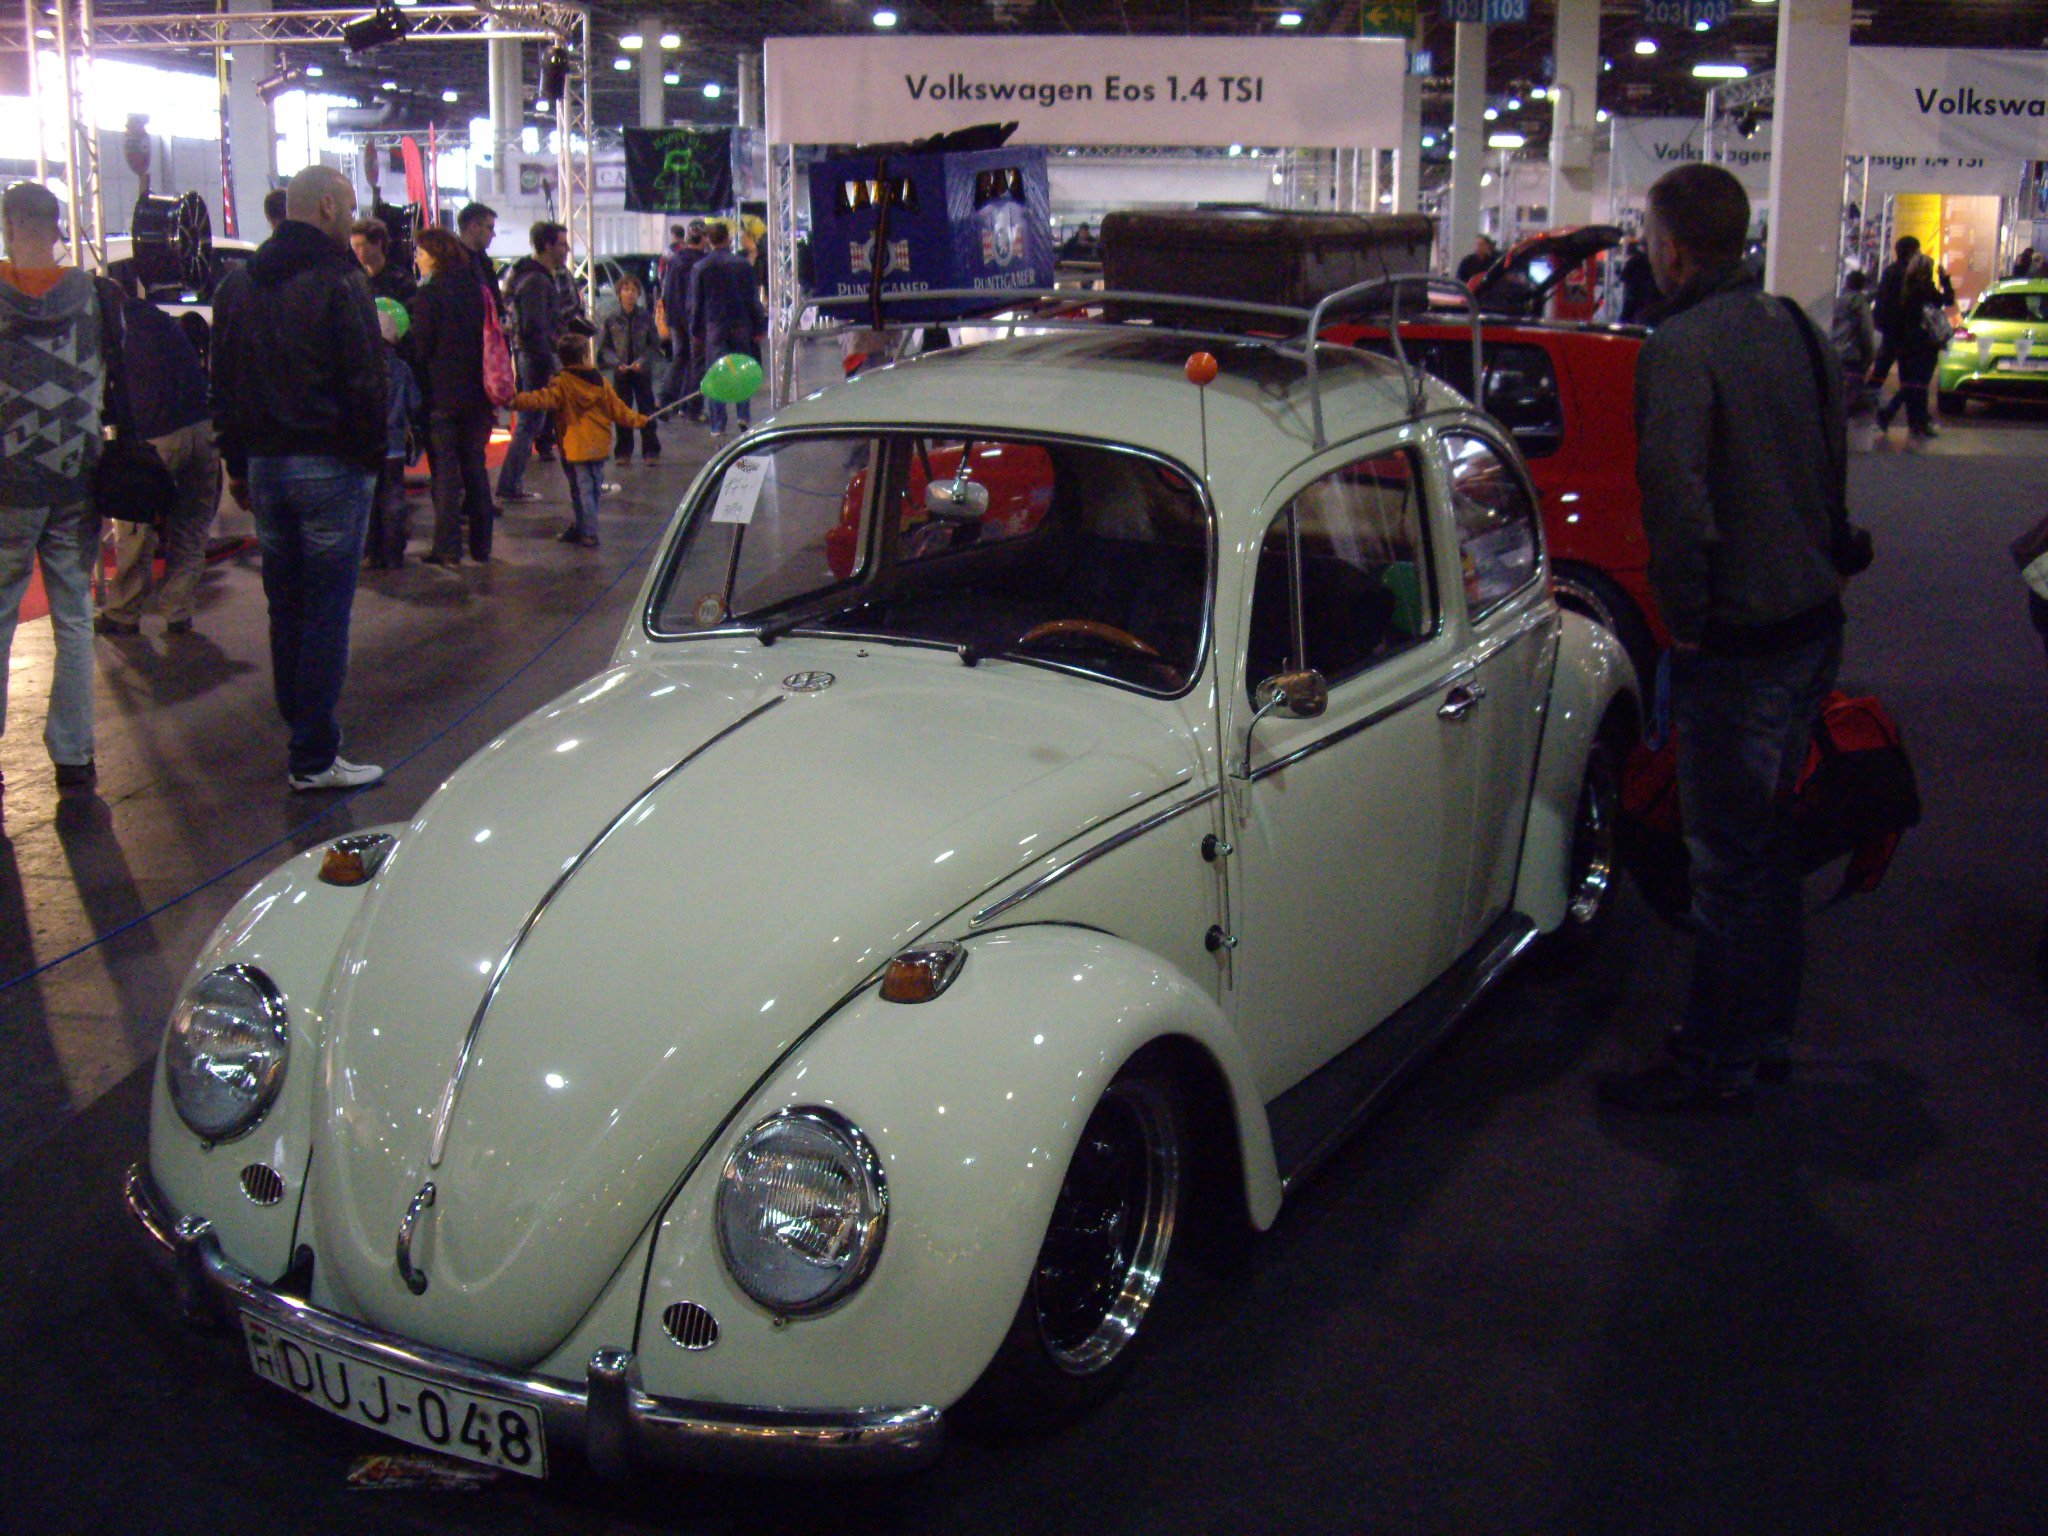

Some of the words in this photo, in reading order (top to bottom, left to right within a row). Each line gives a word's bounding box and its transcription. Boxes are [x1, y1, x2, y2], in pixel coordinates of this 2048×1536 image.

[1491, 0, 1525, 20] 103
[905, 73, 1093, 107] Volkswagen
[1105, 75, 1156, 102] Eos
[1167, 75, 1208, 102] 1.4
[1219, 76, 1264, 103] TSI
[1914, 87, 2048, 117] Volkswa
[279, 1337, 533, 1466] DUJ-048
